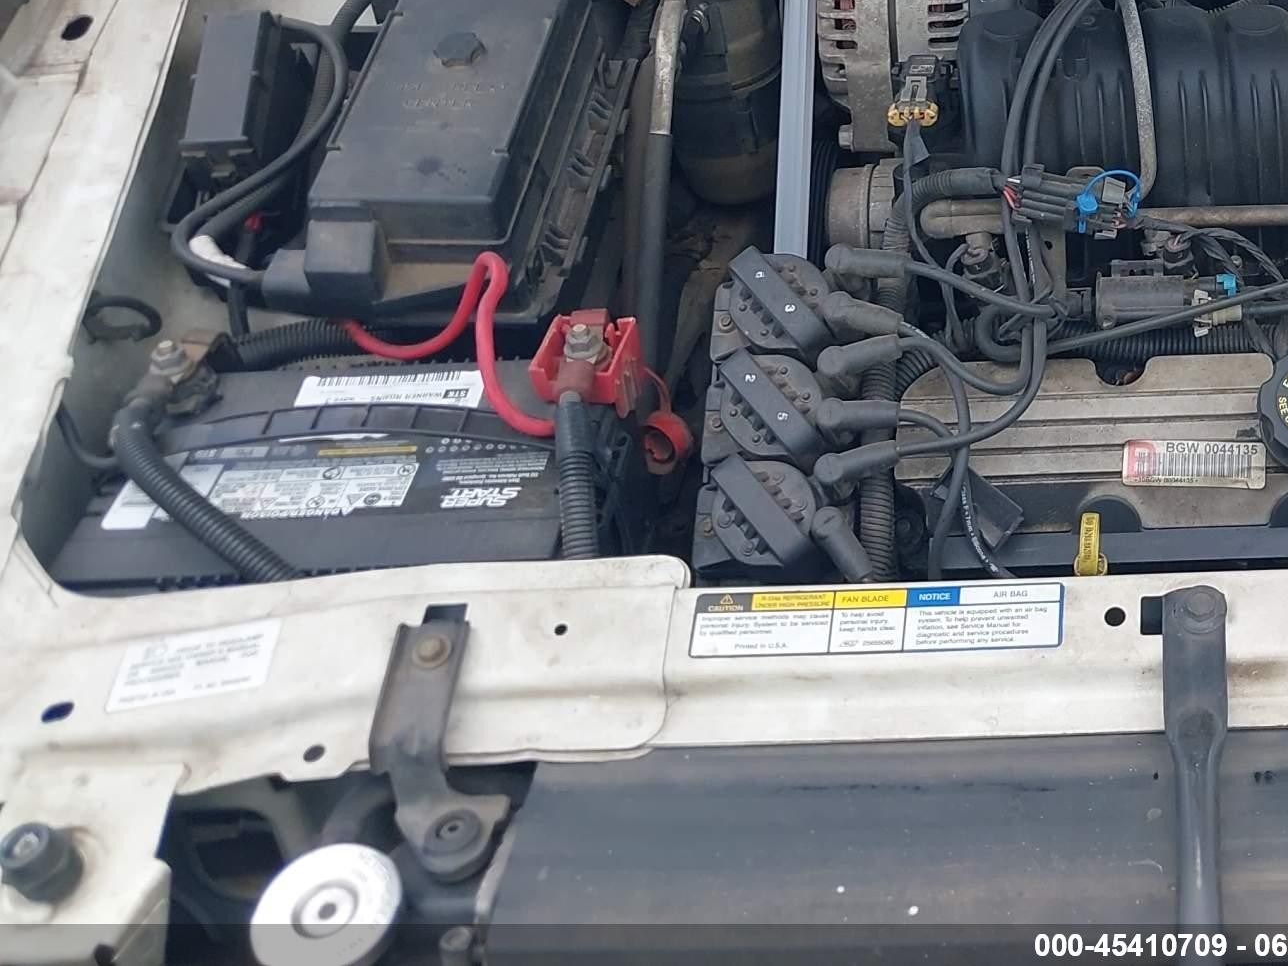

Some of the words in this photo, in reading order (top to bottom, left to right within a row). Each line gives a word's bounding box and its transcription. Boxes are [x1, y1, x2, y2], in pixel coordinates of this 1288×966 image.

[785, 304, 795, 313] 3
[745, 374, 755, 383] 2
[1278, 396, 1288, 416] SEE
[777, 412, 788, 421] 5
[1166, 442, 1199, 453] BGW
[1204, 443, 1258, 455] 0044135
[450, 486, 522, 499] START
[440, 495, 507, 508] SUPER
[841, 595, 859, 603] FAN
[861, 594, 889, 603] BLADE
[918, 592, 952, 602] NOTICE
[993, 590, 1007, 598] AIR
[1010, 590, 1029, 598] BAG
[708, 604, 744, 612] CAUTION
